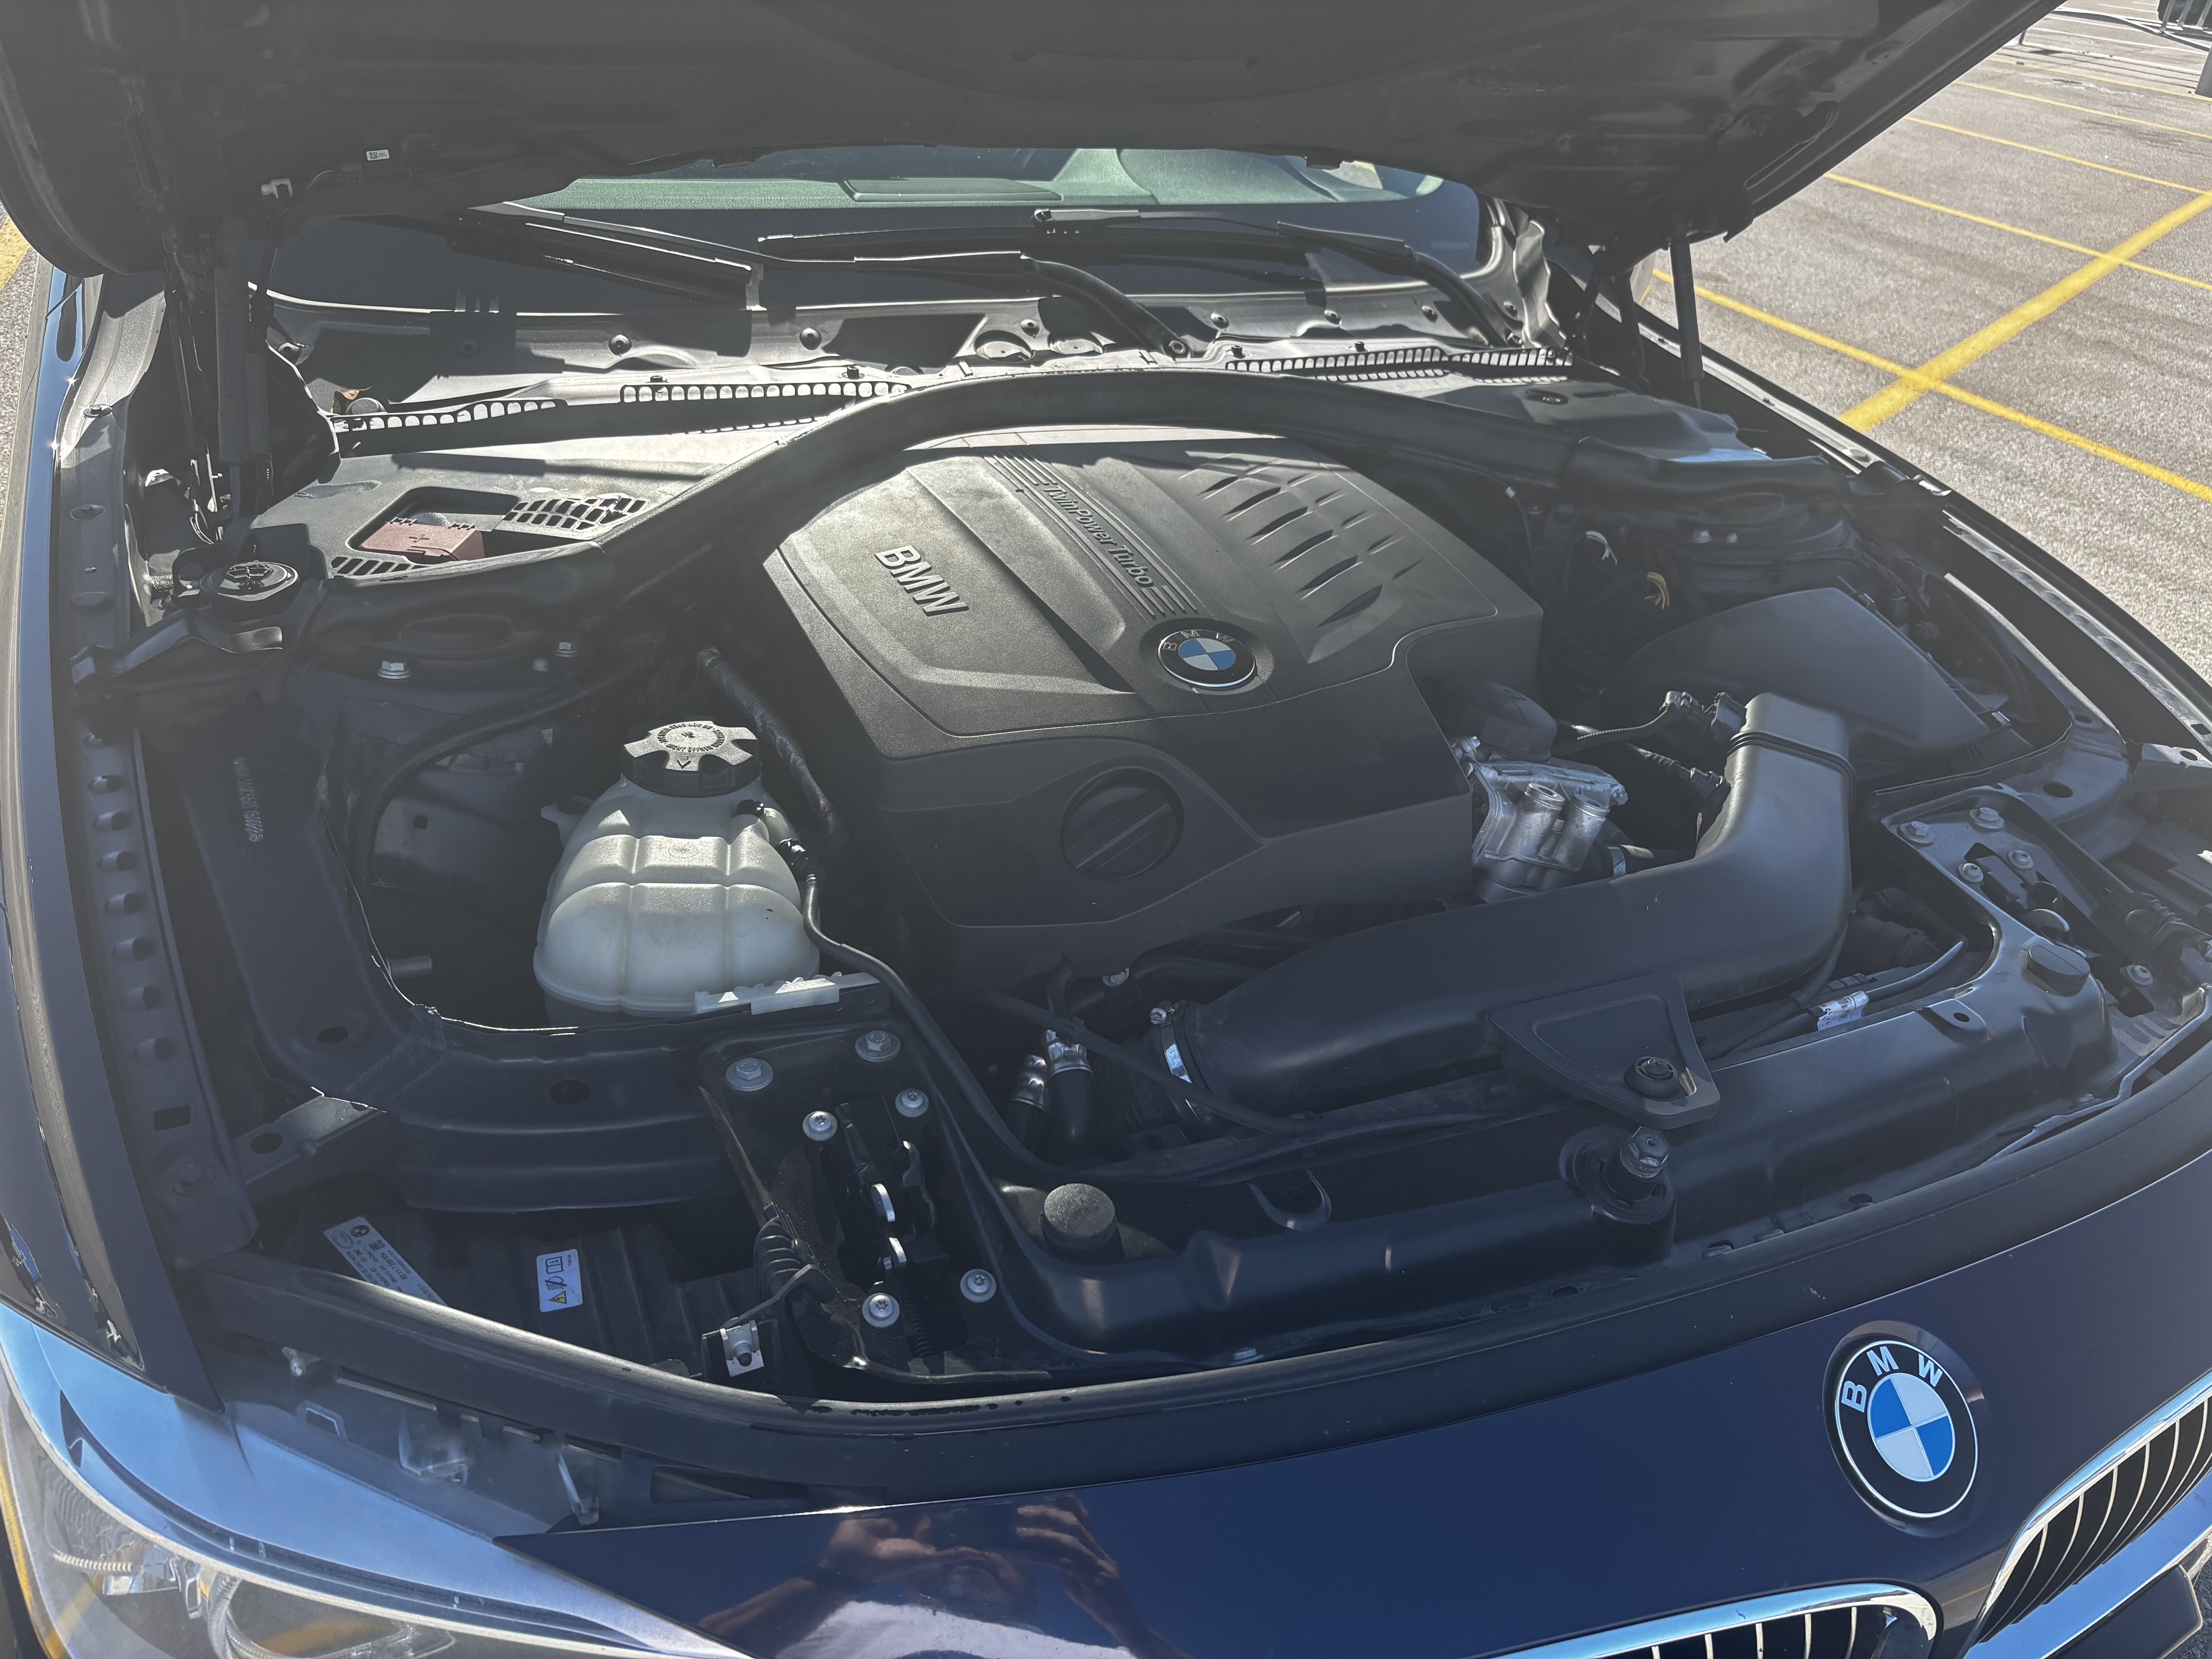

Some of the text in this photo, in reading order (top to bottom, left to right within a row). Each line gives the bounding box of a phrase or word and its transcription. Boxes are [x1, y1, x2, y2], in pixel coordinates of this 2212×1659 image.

[1043, 485, 1154, 587] TwinPower Turbo
[875, 545, 969, 617] BMW
[1162, 630, 1235, 651] BMW
[1841, 1346, 1943, 1413] BMW
